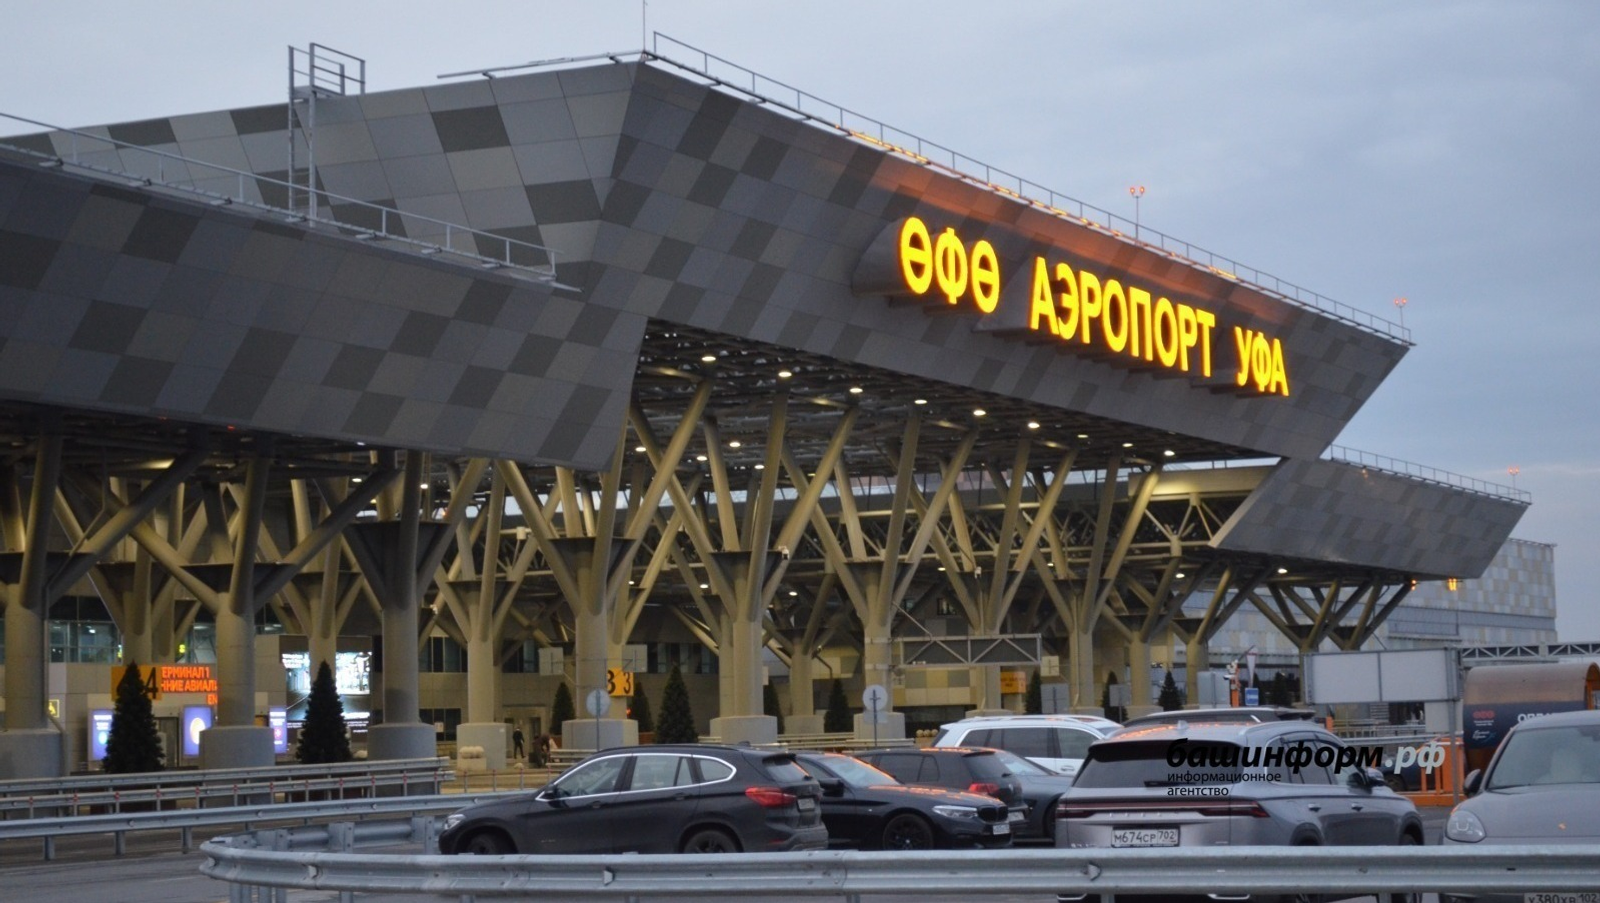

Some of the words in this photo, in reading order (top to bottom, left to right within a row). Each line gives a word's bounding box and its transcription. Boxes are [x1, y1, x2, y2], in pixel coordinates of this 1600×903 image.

[1029, 256, 1216, 377] АЭРОПОРТ
[1234, 326, 1290, 397] УФА
[144, 667, 159, 699] 4
[161, 666, 204, 679] ЕРМИНАЛ
[623, 672, 631, 694] 3
[1158, 830, 1175, 840] 702
